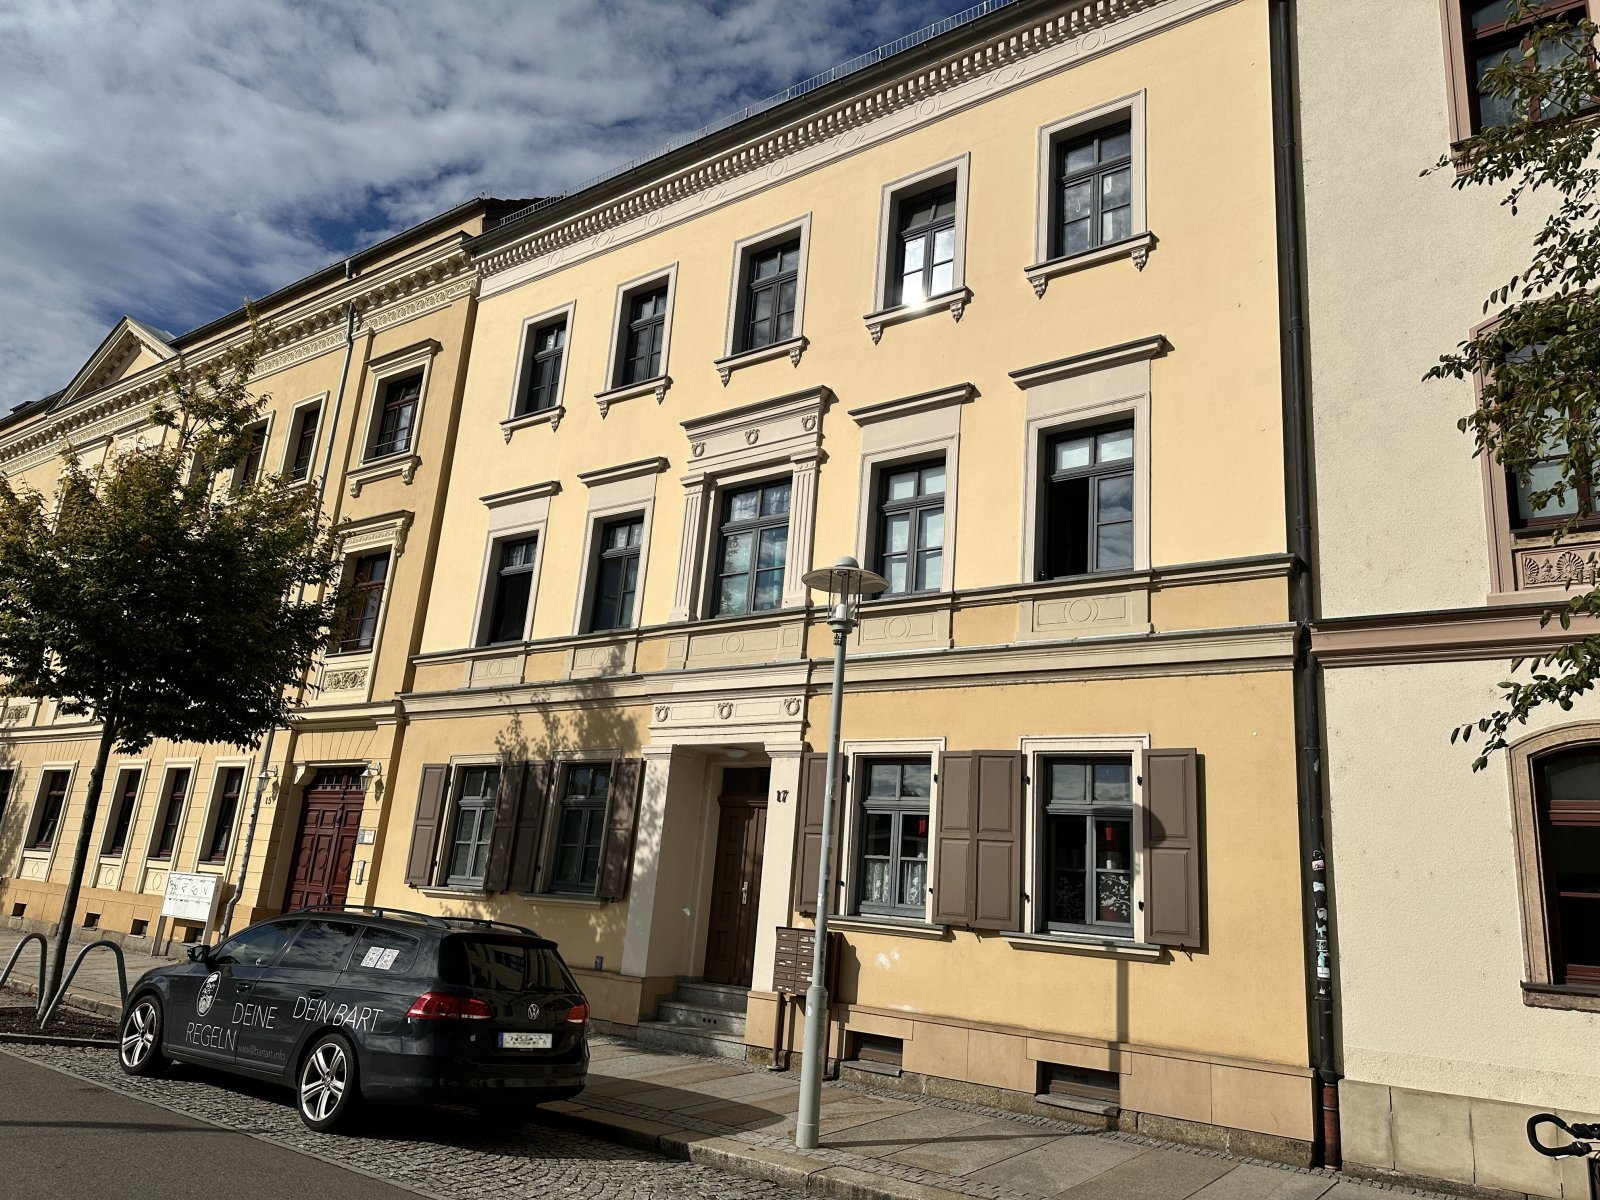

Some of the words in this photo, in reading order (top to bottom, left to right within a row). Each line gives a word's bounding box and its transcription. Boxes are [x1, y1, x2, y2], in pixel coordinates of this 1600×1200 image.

[265, 796, 272, 805] 15
[776, 789, 789, 803] 17
[231, 1002, 278, 1029] DEINE
[292, 996, 335, 1024] DEIN
[332, 1003, 384, 1032] BART
[185, 1022, 238, 1051] REGELN
